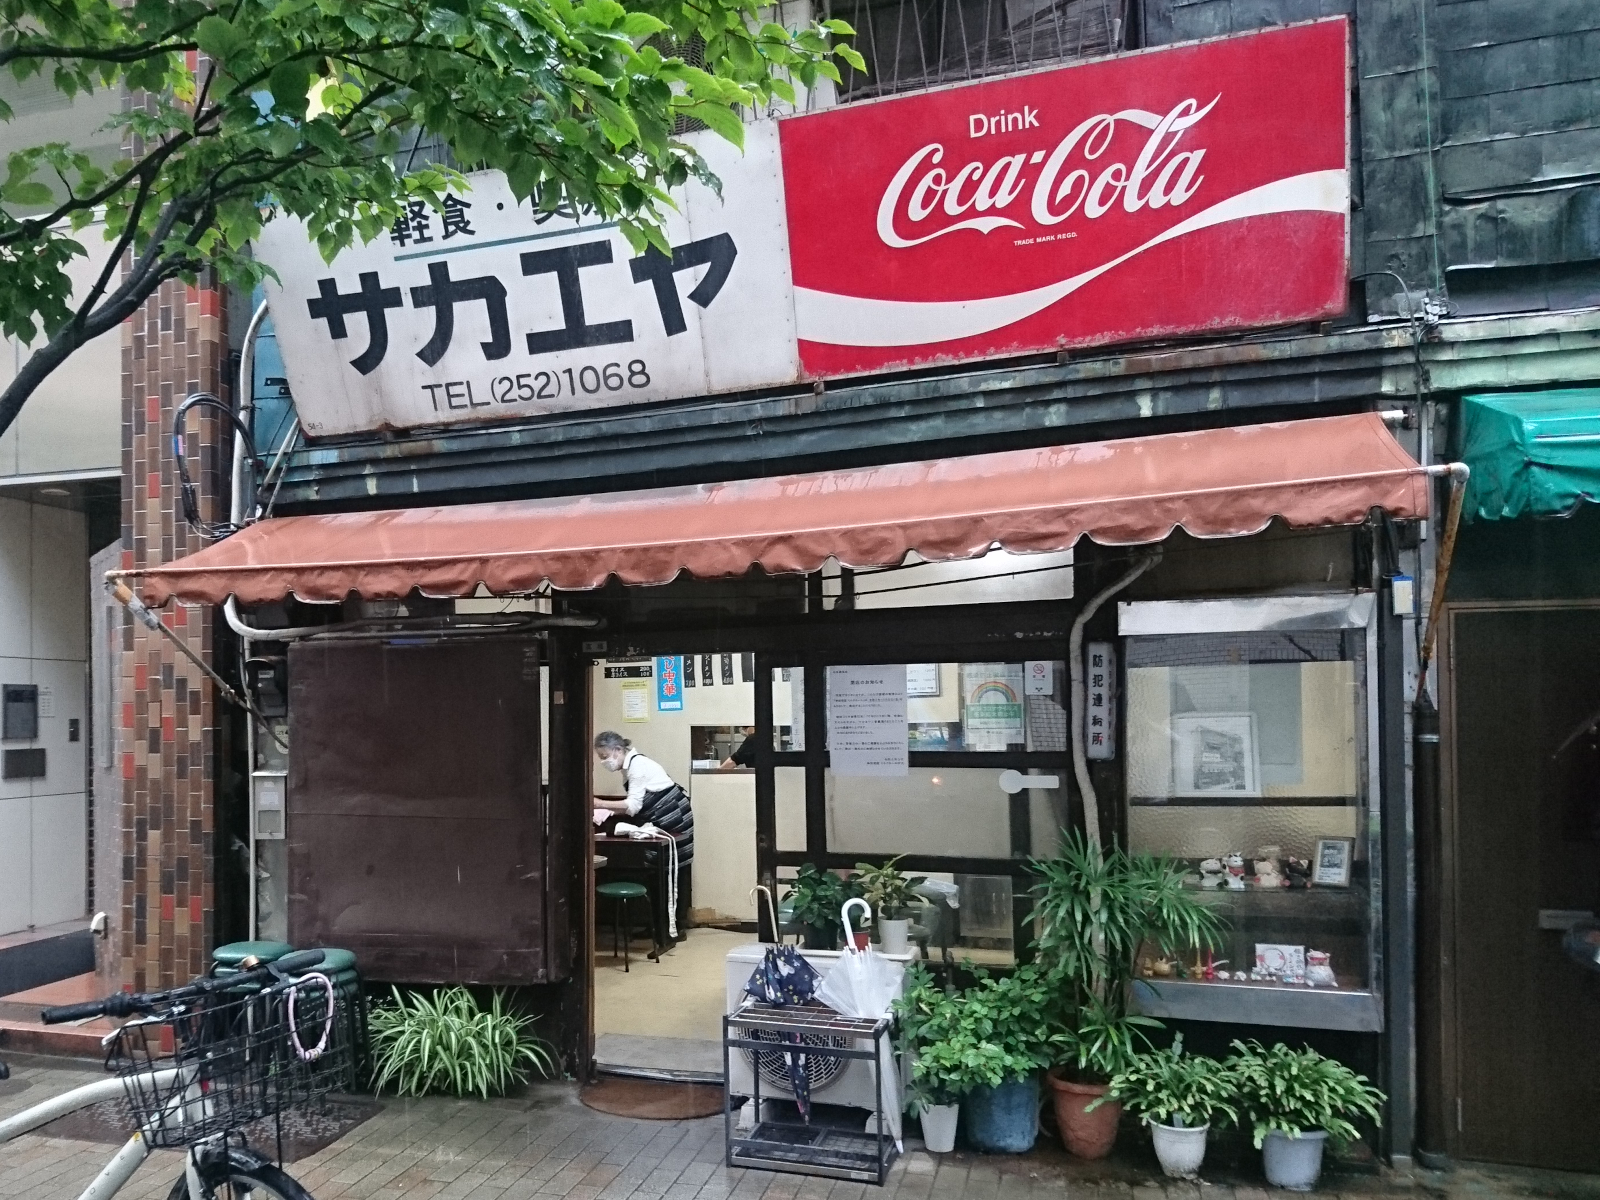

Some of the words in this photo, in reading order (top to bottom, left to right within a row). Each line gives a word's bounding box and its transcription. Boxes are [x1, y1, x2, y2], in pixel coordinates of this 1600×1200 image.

[969, 105, 1040, 138] Drink
[877, 92, 1222, 248] Coca-Cola
[1013, 238, 1035, 246] TRADE
[1036, 235, 1056, 243] MARK
[307, 232, 738, 376] サカエヤ
